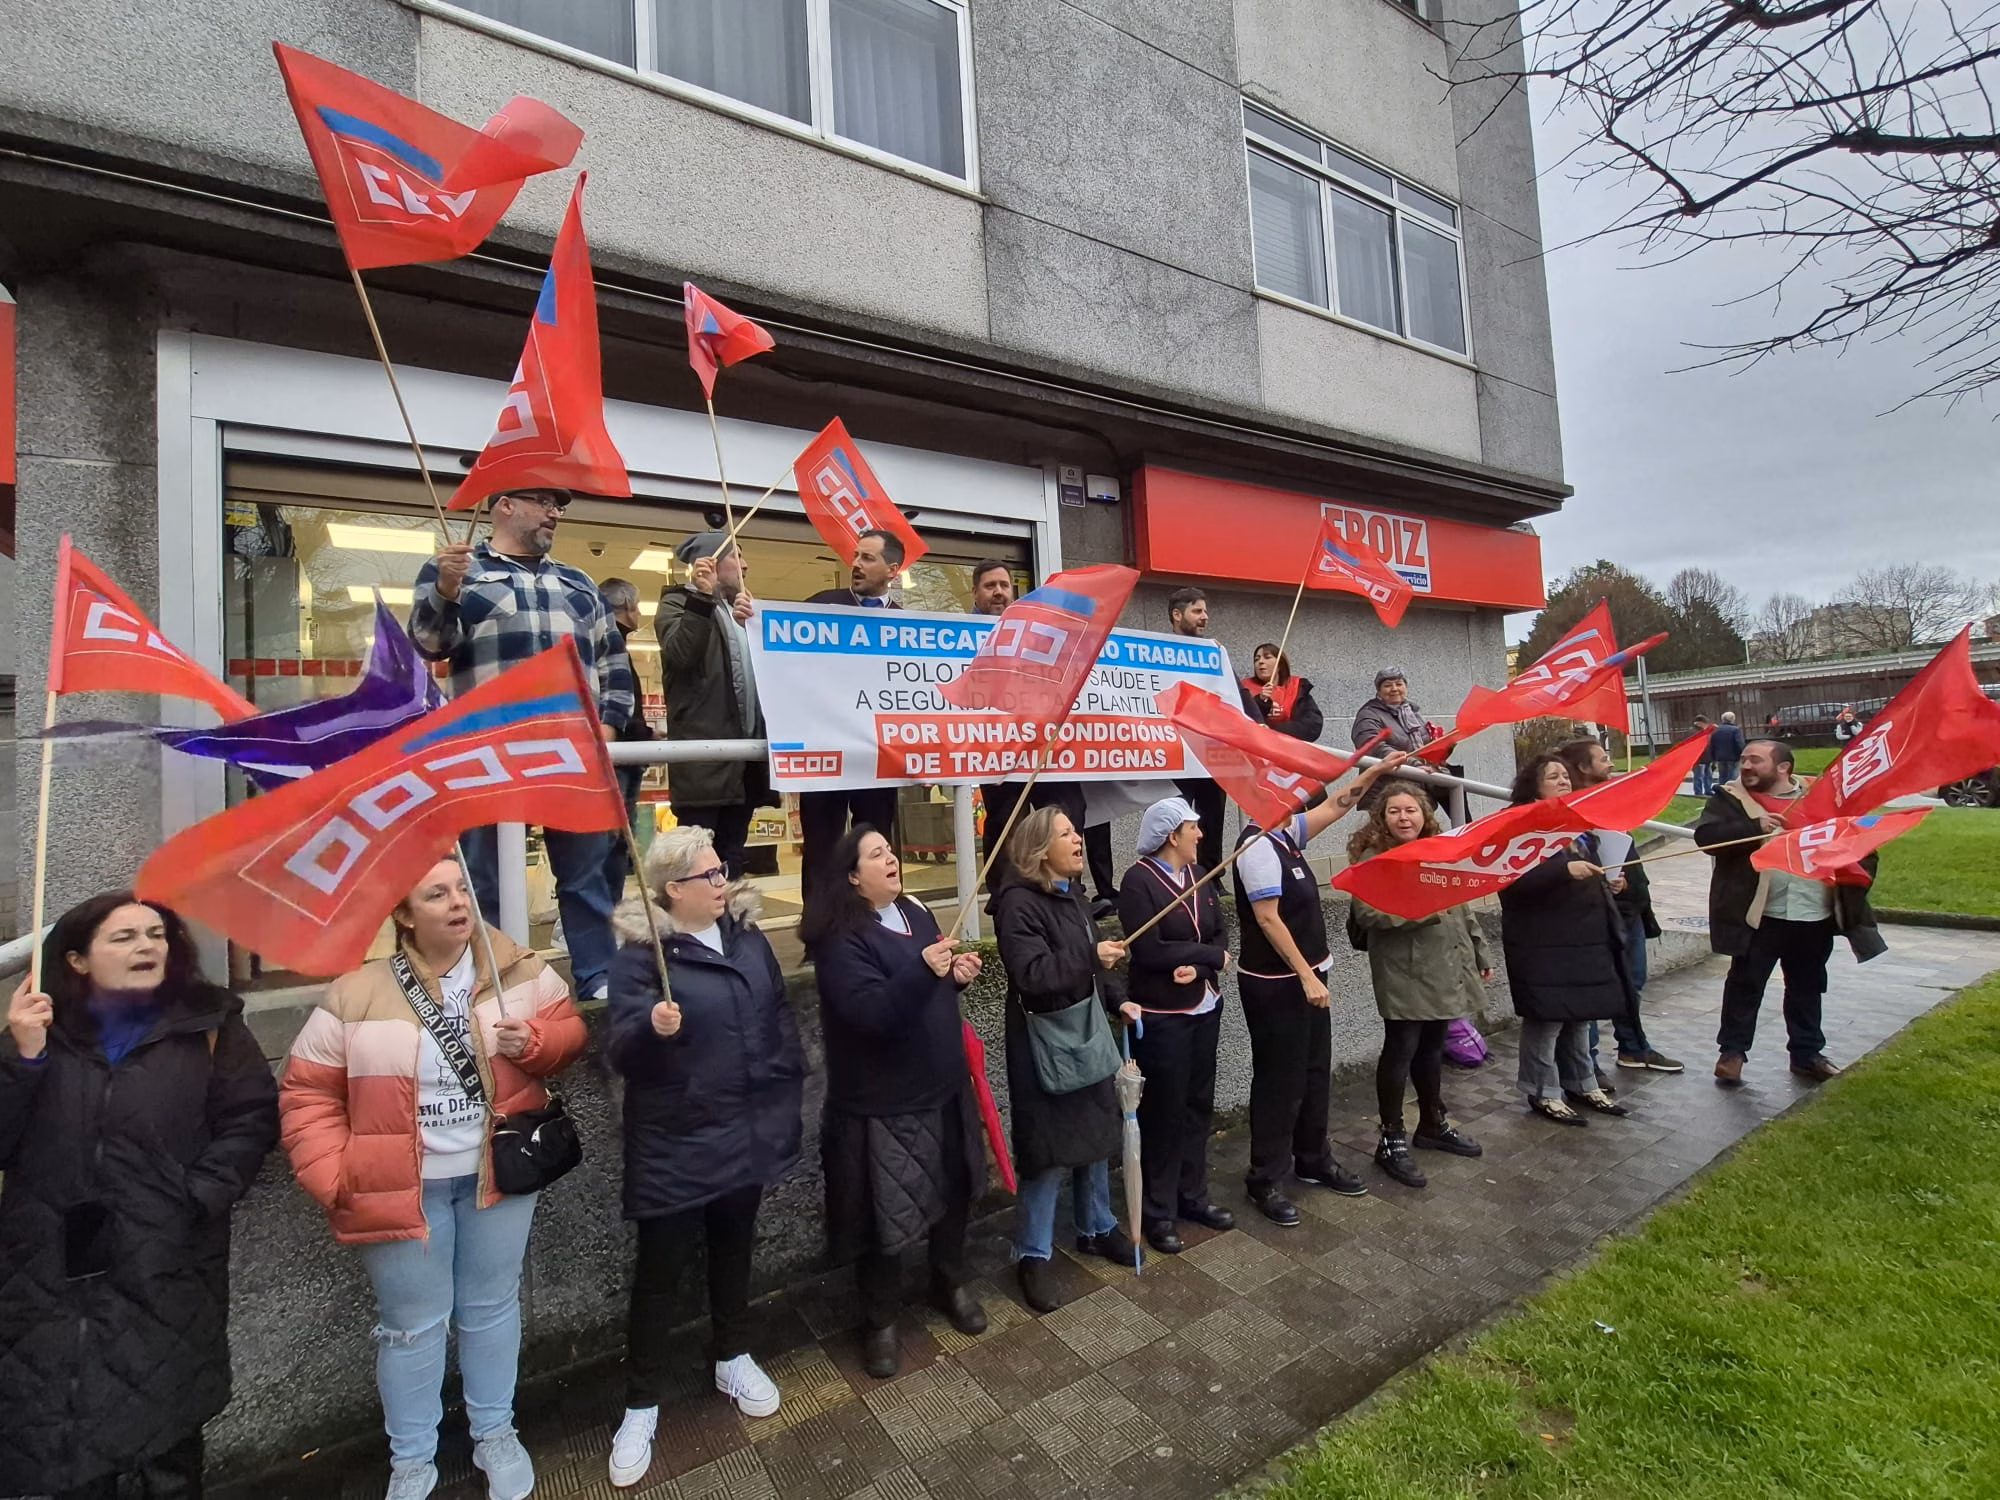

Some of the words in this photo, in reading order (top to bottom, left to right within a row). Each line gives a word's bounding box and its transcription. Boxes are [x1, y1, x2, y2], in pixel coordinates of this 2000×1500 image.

[769, 618, 839, 645] NON
[850, 624, 871, 647] A
[1124, 642, 1220, 670] TRABALLO
[886, 661, 953, 683] POLO
[1089, 667, 1146, 690] SAÚDE
[1150, 674, 1161, 691] E
[856, 690, 872, 709] A
[881, 723, 941, 745] POR
[947, 722, 1037, 744] UNHAS
[1043, 719, 1178, 743] CONDICIÓNS
[775, 756, 838, 773] CCOO
[905, 753, 941, 775] DE
[953, 751, 1076, 774] TRABALLO
[1084, 749, 1167, 770] DIGNAS
[417, 1102, 444, 1116] ETIC
[418, 1112, 480, 1128] TABLISHED
